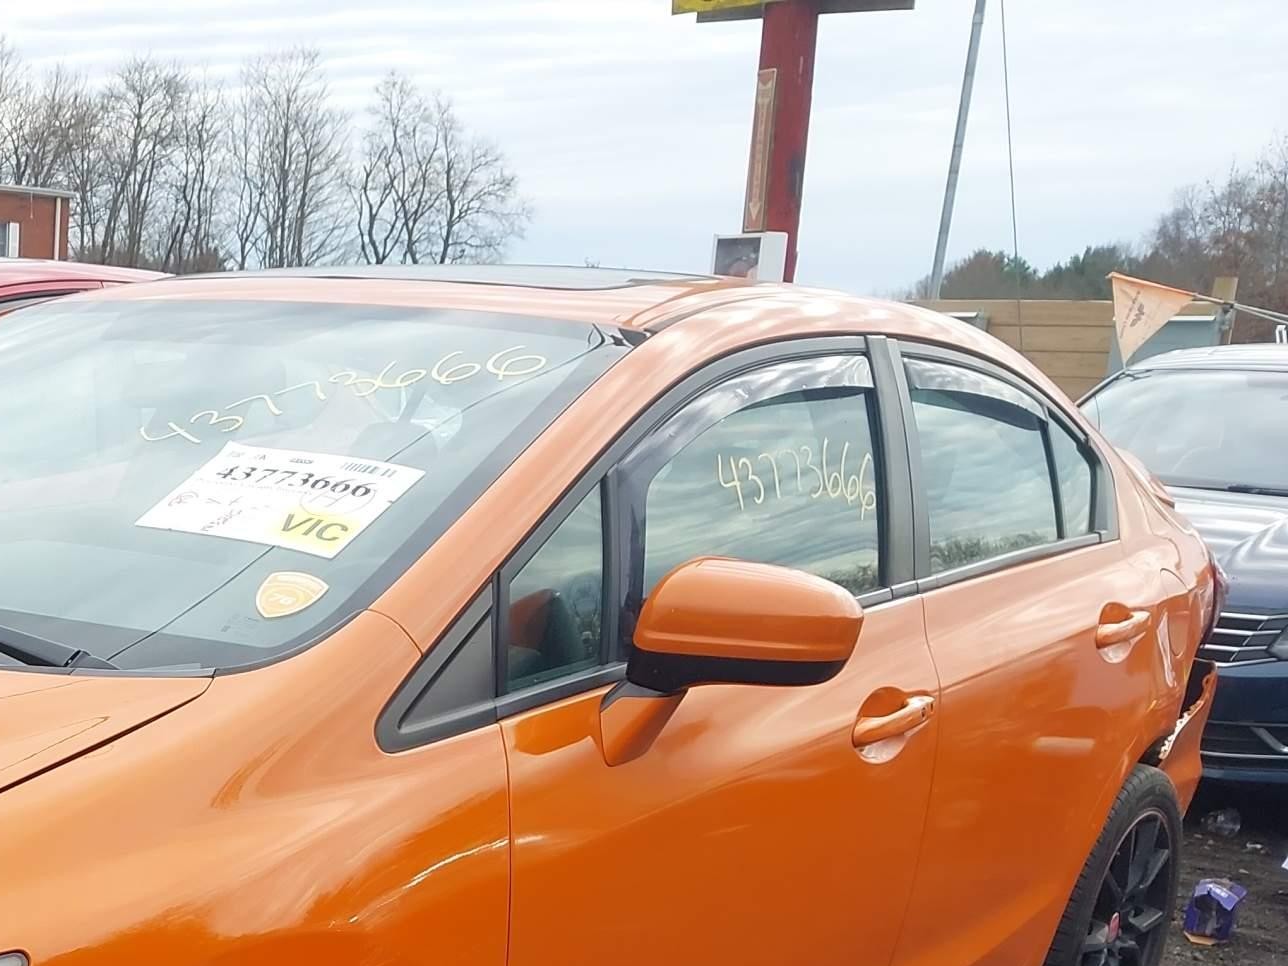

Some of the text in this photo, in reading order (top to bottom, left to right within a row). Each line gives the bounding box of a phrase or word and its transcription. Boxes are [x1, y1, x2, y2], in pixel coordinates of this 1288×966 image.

[139, 345, 547, 445] 43773666
[215, 464, 377, 498] 43773666
[717, 436, 877, 521] 43773666
[280, 513, 349, 542] VIC
